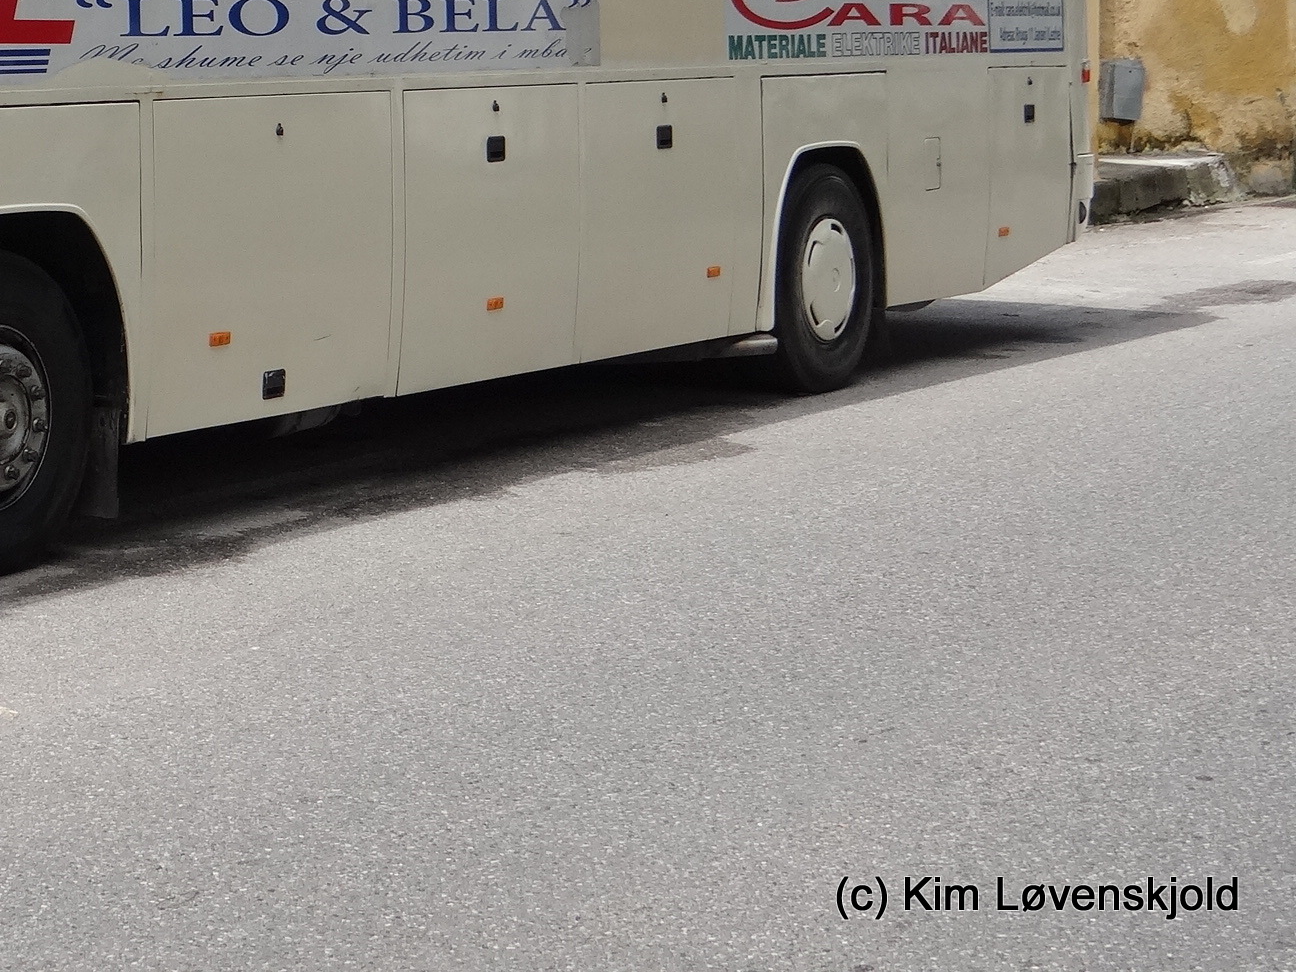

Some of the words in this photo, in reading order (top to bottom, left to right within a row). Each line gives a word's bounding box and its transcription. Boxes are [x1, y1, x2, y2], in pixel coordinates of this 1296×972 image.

[150, 45, 262, 69] shume
[267, 54, 304, 67] se
[308, 48, 362, 75] nje
[368, 41, 485, 64] udhetim
[491, 44, 512, 60] i
[728, 33, 827, 60] MATERIALE
[831, 31, 921, 58] ELEKTRIKE
[924, 31, 989, 55] ITALIANE
